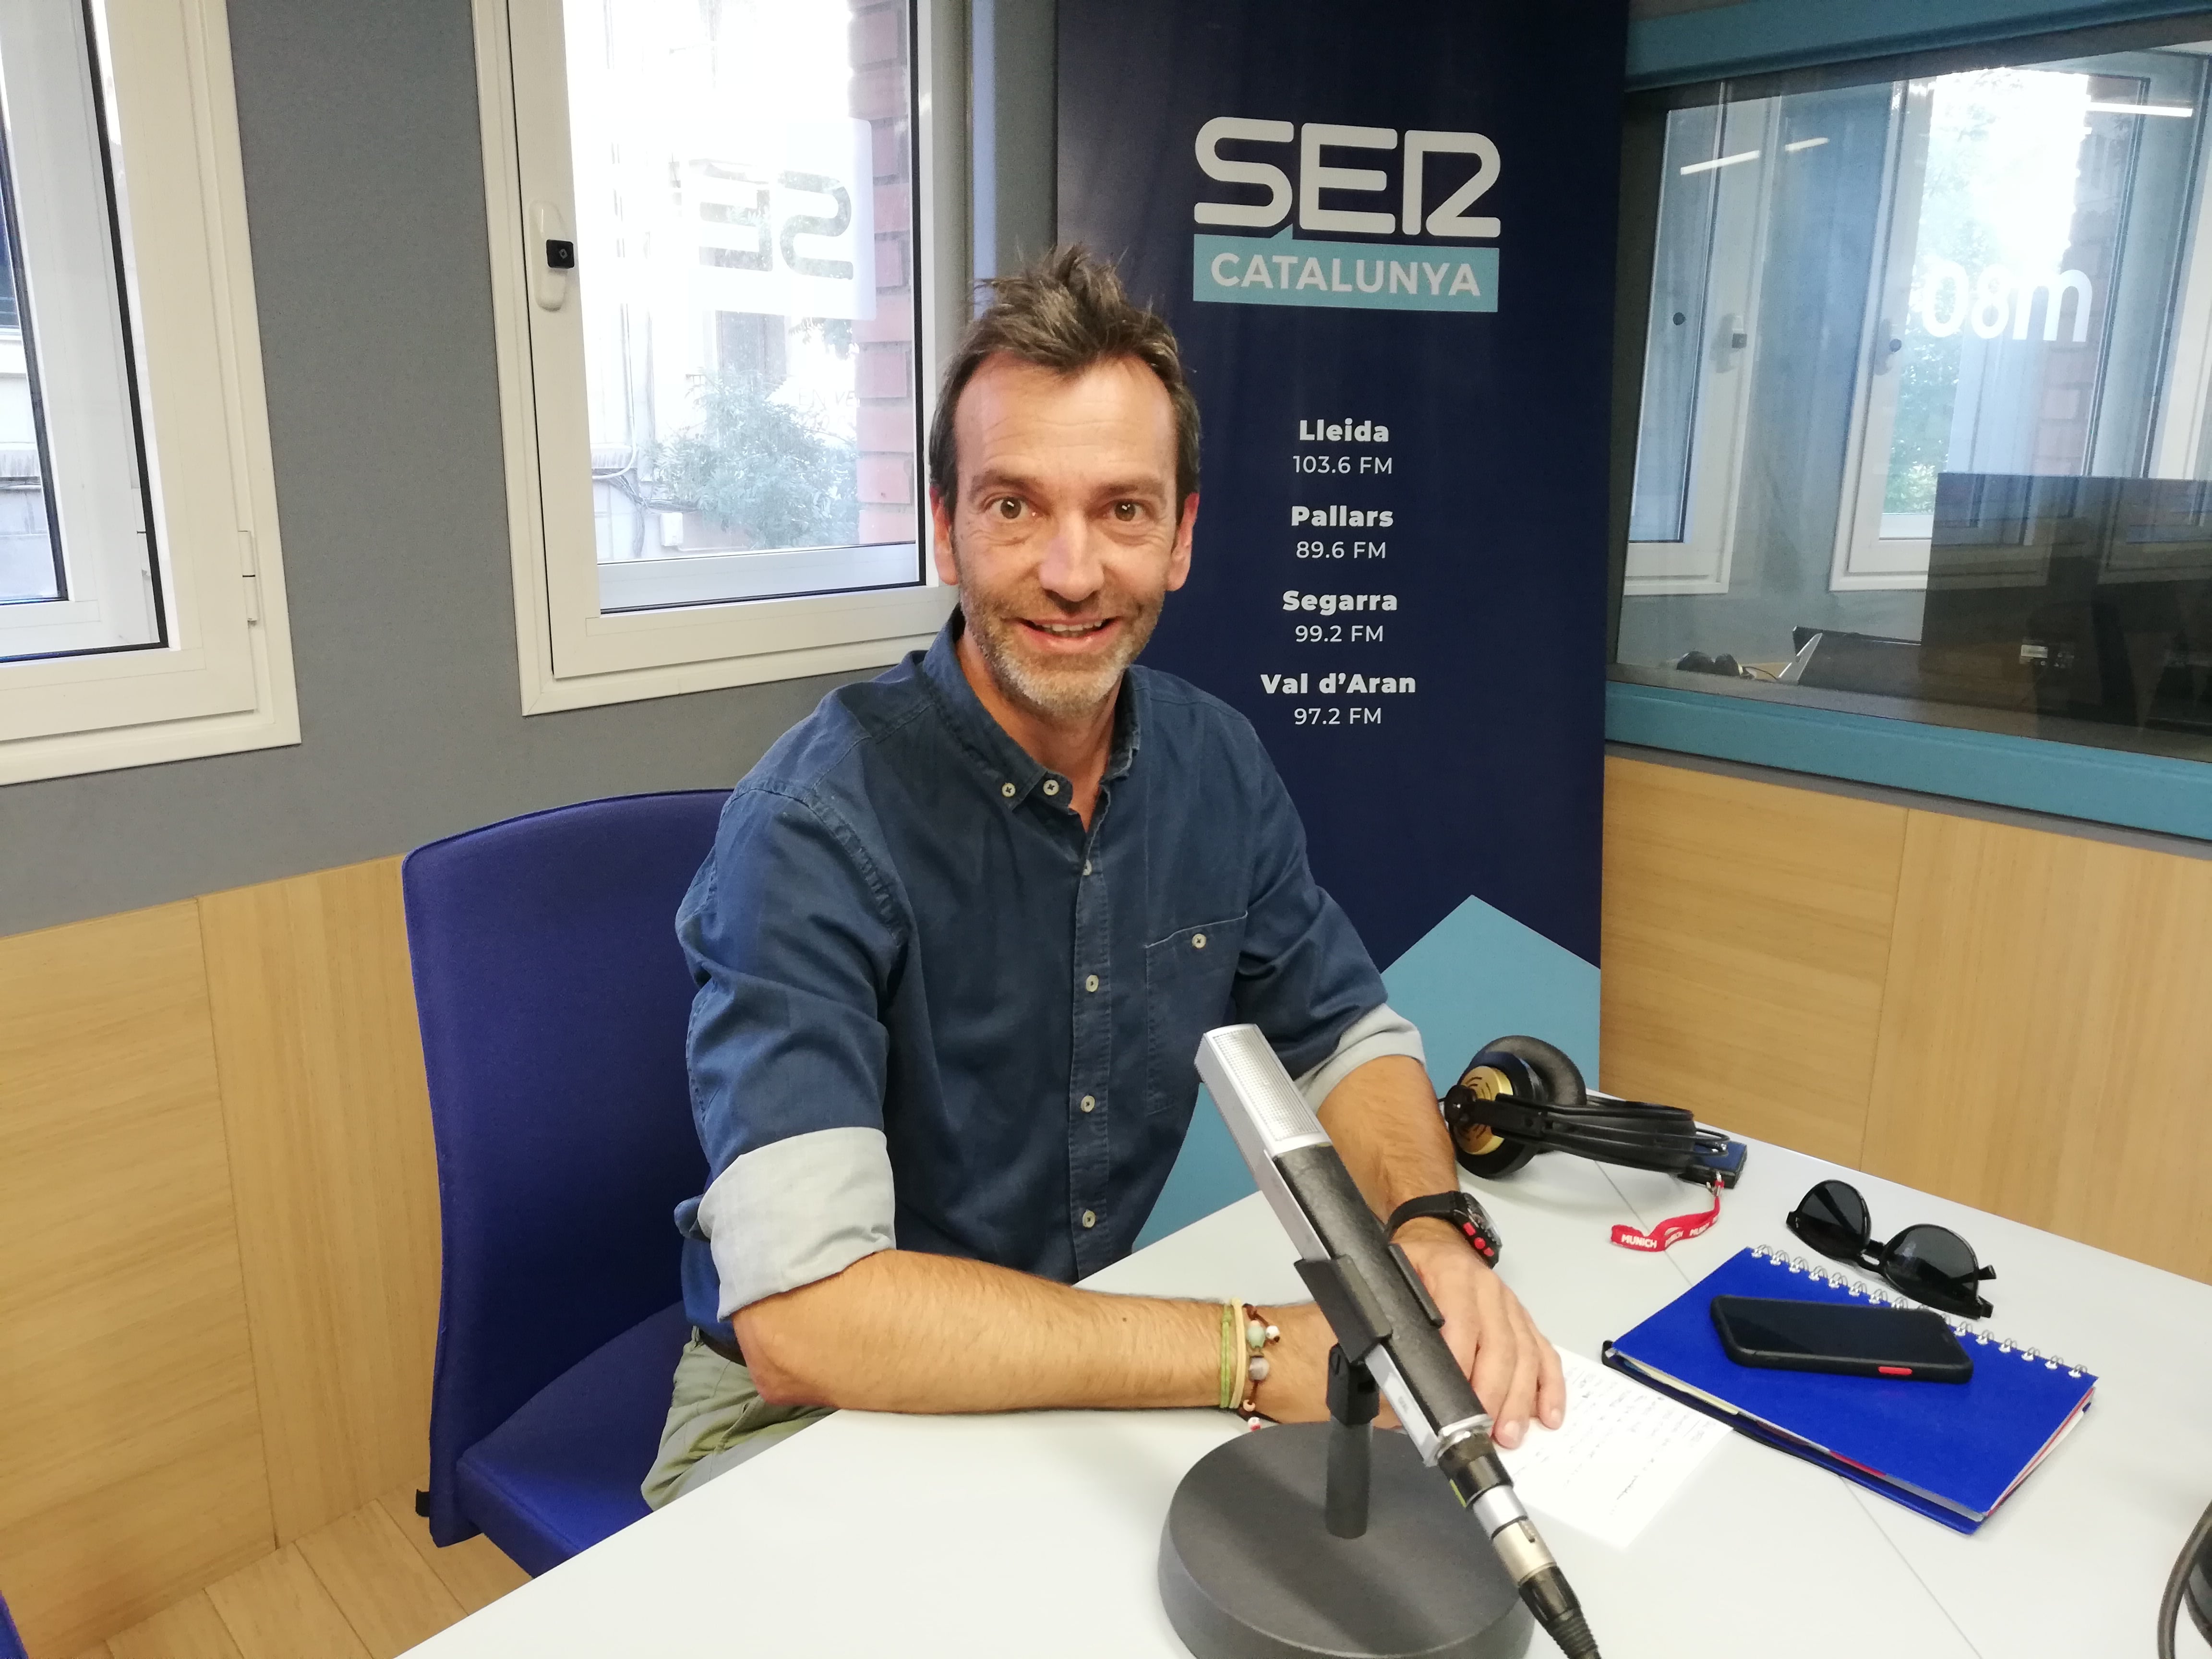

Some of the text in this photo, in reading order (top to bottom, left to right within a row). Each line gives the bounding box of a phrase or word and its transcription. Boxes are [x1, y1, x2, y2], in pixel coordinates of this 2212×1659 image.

[1194, 116, 1501, 238] SER
[1211, 252, 1480, 296] CATALUNYA
[1299, 417, 1389, 442] Lleida
[1293, 456, 1393, 474] 103.6 FM
[1291, 505, 1394, 527] Pallars
[1296, 541, 1386, 559] 89.6 FM
[1282, 589, 1398, 616] Segarra
[1295, 625, 1383, 642] 99.2 FM
[1260, 673, 1416, 694] Val d’Aran
[1294, 707, 1382, 725] 97.2 FM
[1621, 1233, 1658, 1249] MUNICH
